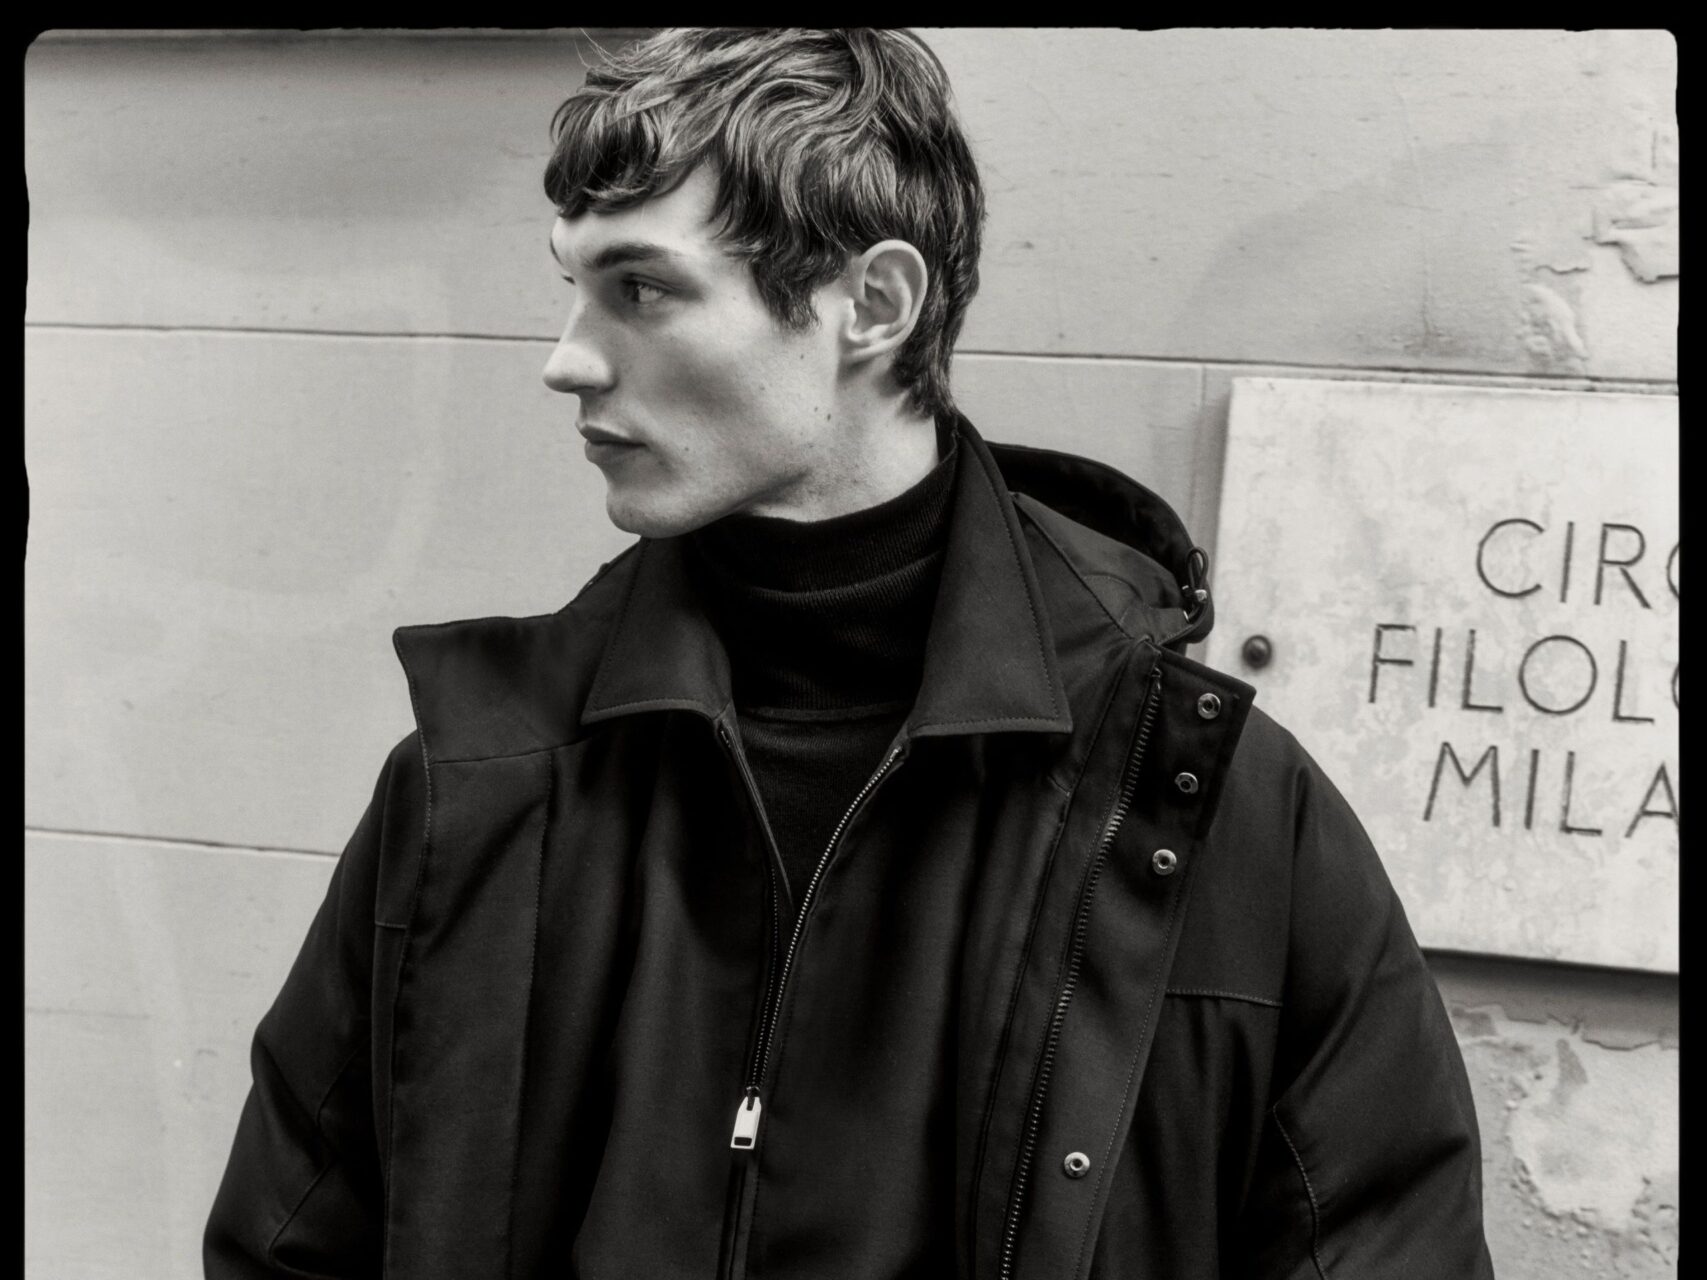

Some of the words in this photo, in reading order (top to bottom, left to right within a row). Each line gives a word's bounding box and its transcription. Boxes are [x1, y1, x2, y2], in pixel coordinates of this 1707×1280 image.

[1477, 518, 1679, 609] CIR
[1369, 623, 1679, 724] FILOL
[1423, 741, 1679, 838] MILA
